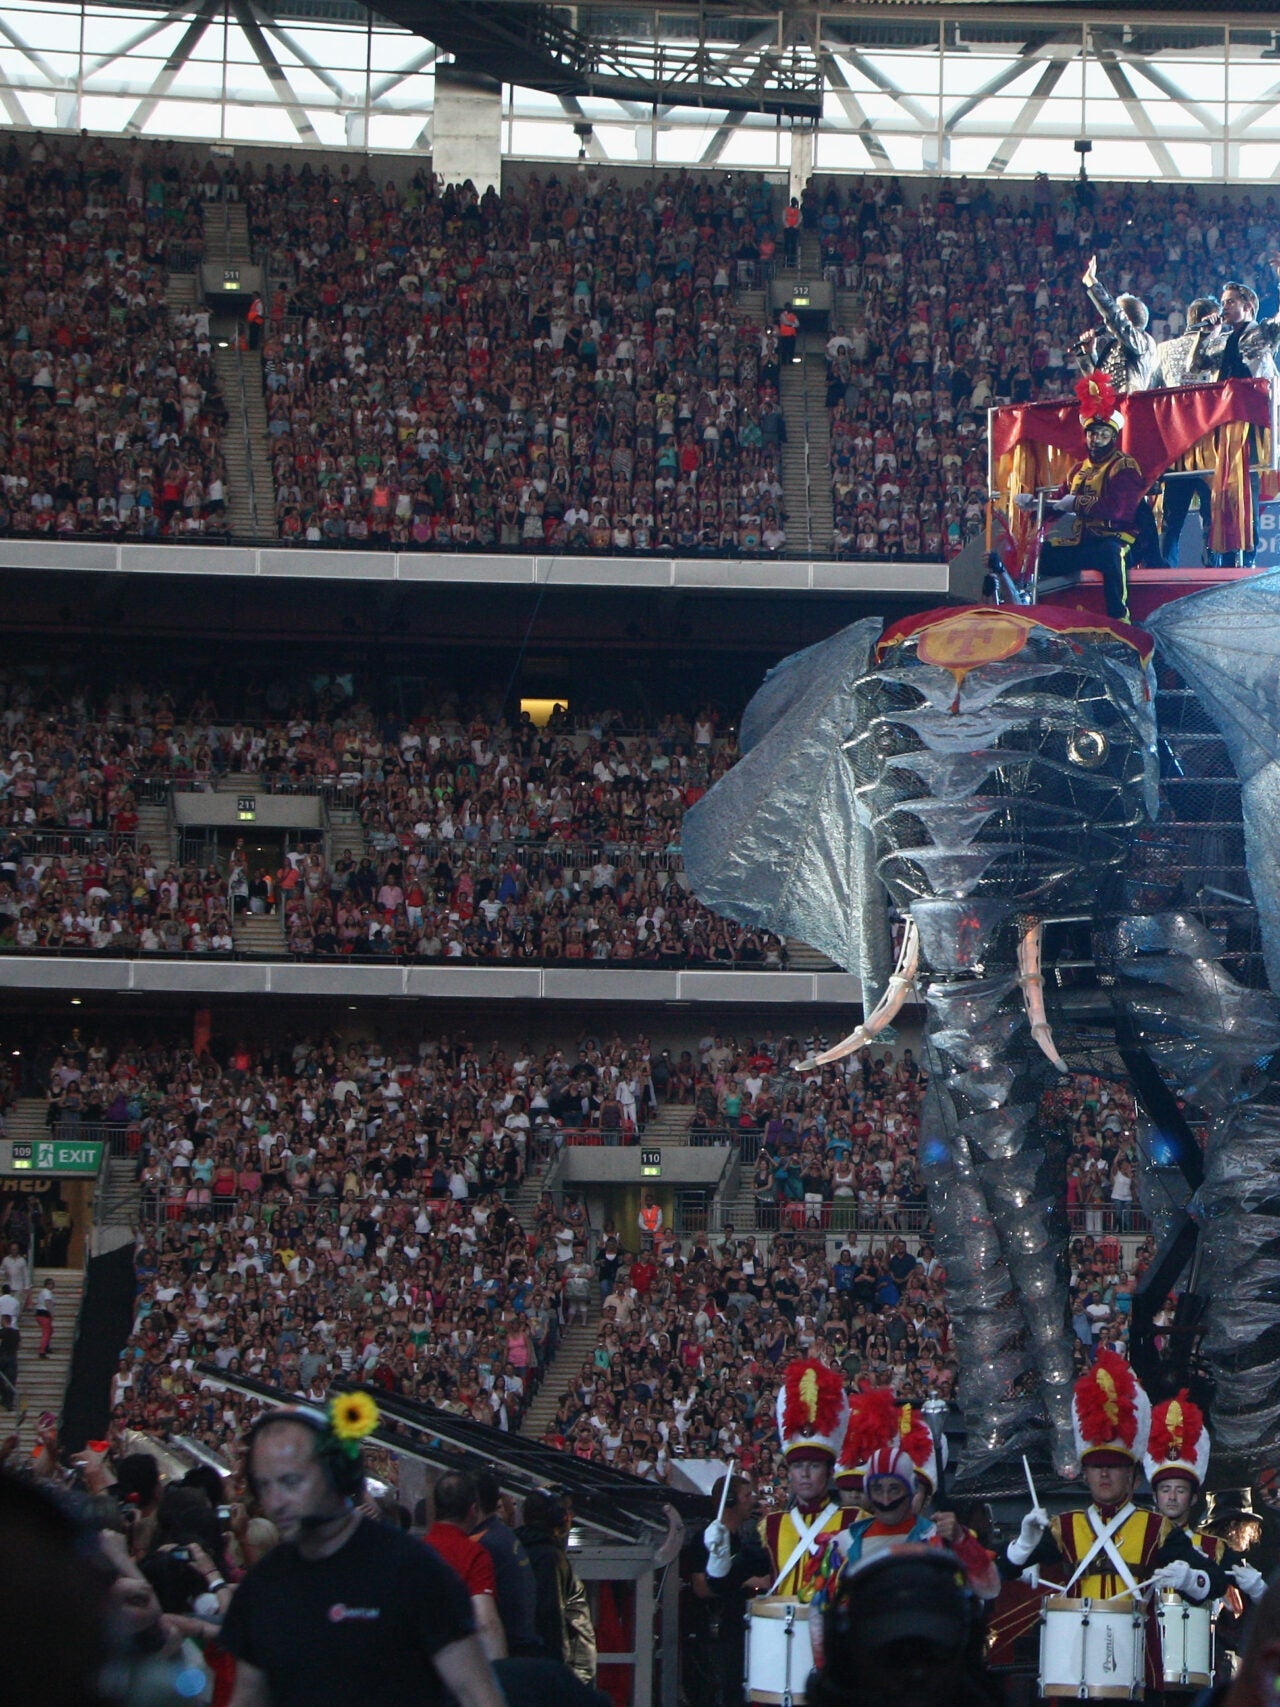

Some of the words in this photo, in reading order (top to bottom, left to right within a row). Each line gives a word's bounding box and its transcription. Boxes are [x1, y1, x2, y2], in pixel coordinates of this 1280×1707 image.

[224, 271, 239, 279] 511
[793, 287, 808, 295] 512
[238, 800, 255, 809] 211
[13, 1147, 31, 1157] 109
[59, 1150, 96, 1163] EXIT
[642, 1154, 660, 1163] 110
